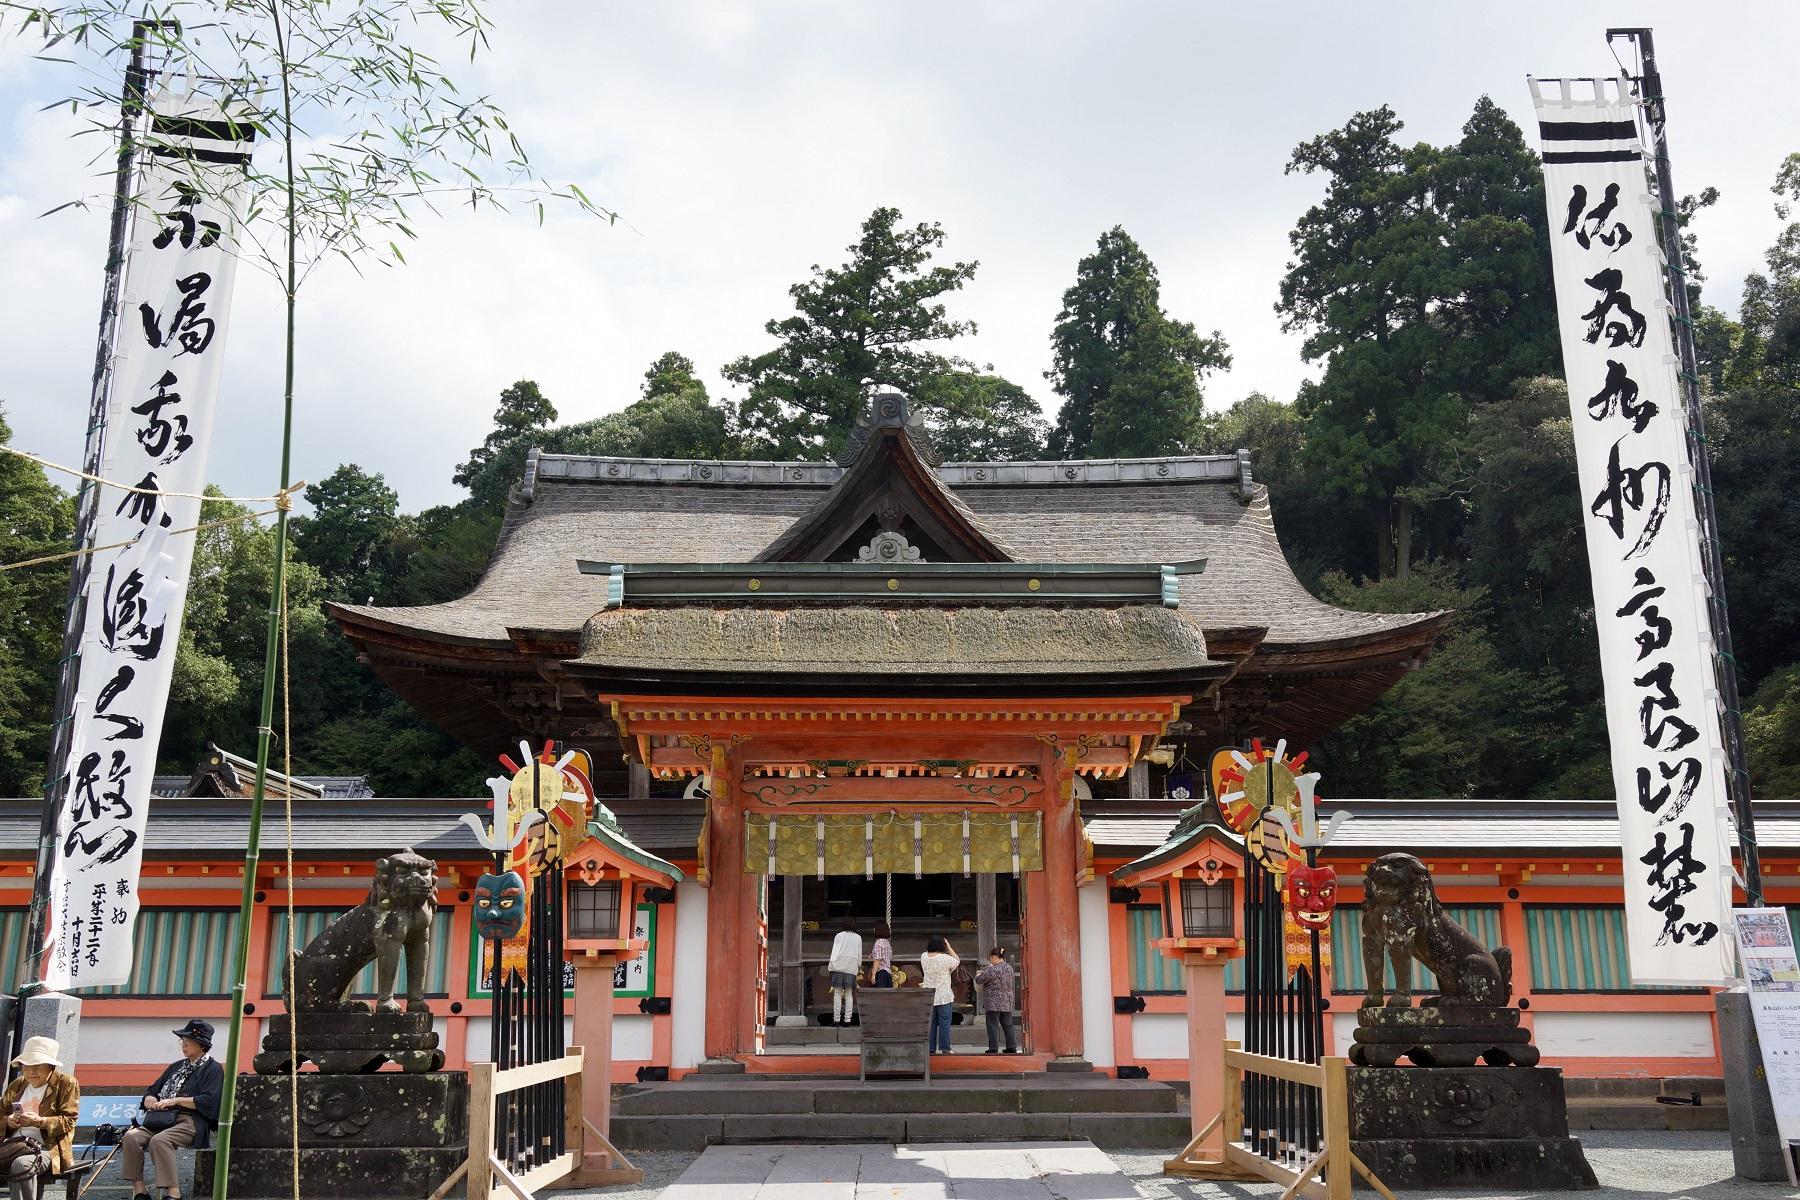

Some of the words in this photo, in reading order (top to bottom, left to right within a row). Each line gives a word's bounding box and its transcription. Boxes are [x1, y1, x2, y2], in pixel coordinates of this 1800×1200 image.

[85, 882, 107, 967] 平成二十二年
[111, 878, 130, 925] 奉納
